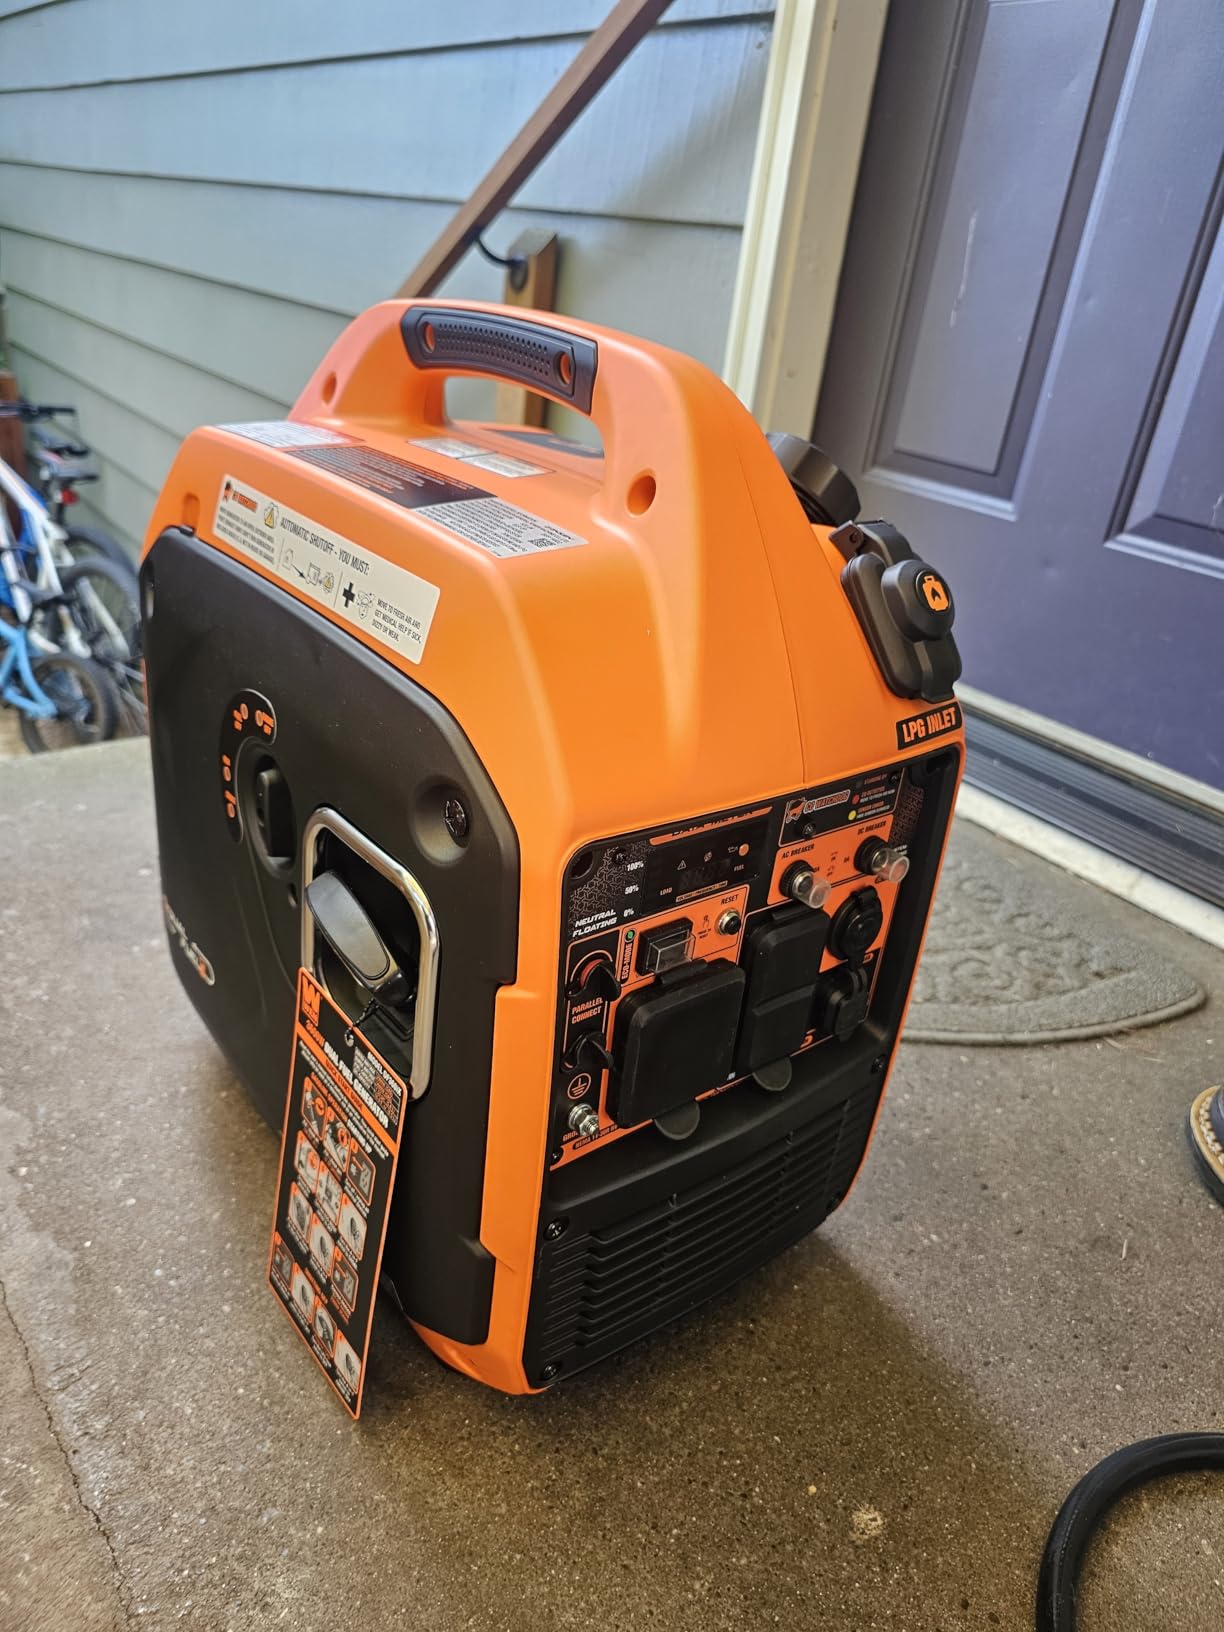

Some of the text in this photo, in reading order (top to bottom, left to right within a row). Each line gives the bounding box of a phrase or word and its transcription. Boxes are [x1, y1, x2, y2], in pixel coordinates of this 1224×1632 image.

[280, 517, 310, 542] AUTOMATIC
[309, 533, 335, 555] SHUTOFF
[339, 548, 351, 565] YOU
[351, 555, 370, 576] MUST:
[902, 707, 956, 743] LPG INLET
[865, 820, 887, 832] BREAKER
[782, 843, 815, 860] AC BREAKER
[627, 860, 645, 872] 100%
[625, 884, 639, 895] 50%
[660, 886, 673, 896] LOAD
[720, 893, 739, 905] RESET
[572, 917, 617, 938] FLOATING
[575, 909, 616, 928] NEUTRAL
[621, 942, 633, 980] ECO-MODE
[571, 1006, 603, 1024] CONNECT
[572, 997, 603, 1016] PARALLEL
[323, 1041, 389, 1129] DUAL FUEL GENERATOR
